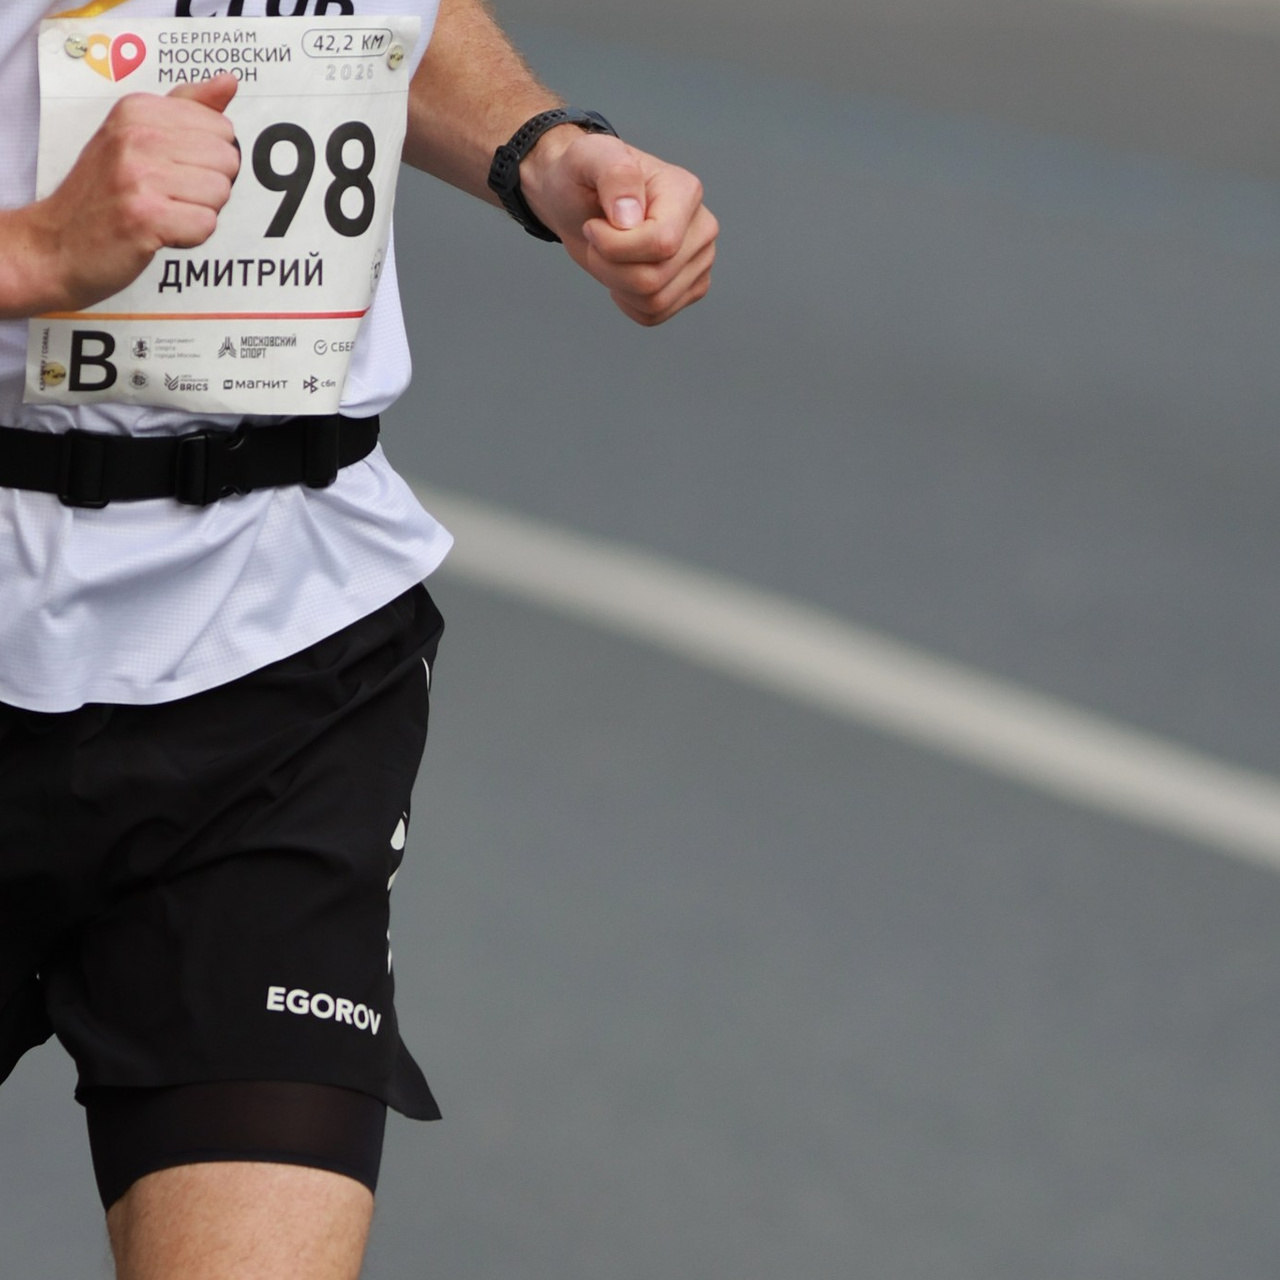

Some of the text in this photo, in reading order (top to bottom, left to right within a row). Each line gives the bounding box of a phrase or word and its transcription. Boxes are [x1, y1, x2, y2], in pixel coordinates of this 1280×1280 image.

[158, 29, 257, 45] СБЕРПРАЙМ
[313, 34, 385, 53] 42,2 КМ
[158, 43, 291, 64] МОСКОВСКИЙ
[231, 121, 376, 238] 98
[158, 251, 323, 294] ДМИТРИЙ
[240, 333, 297, 347] МОСКОВСКИЙ
[68, 330, 117, 391] B
[240, 347, 267, 359] СПОРТ
[179, 383, 209, 391] BRICS
[266, 985, 382, 1036] EGOROV
